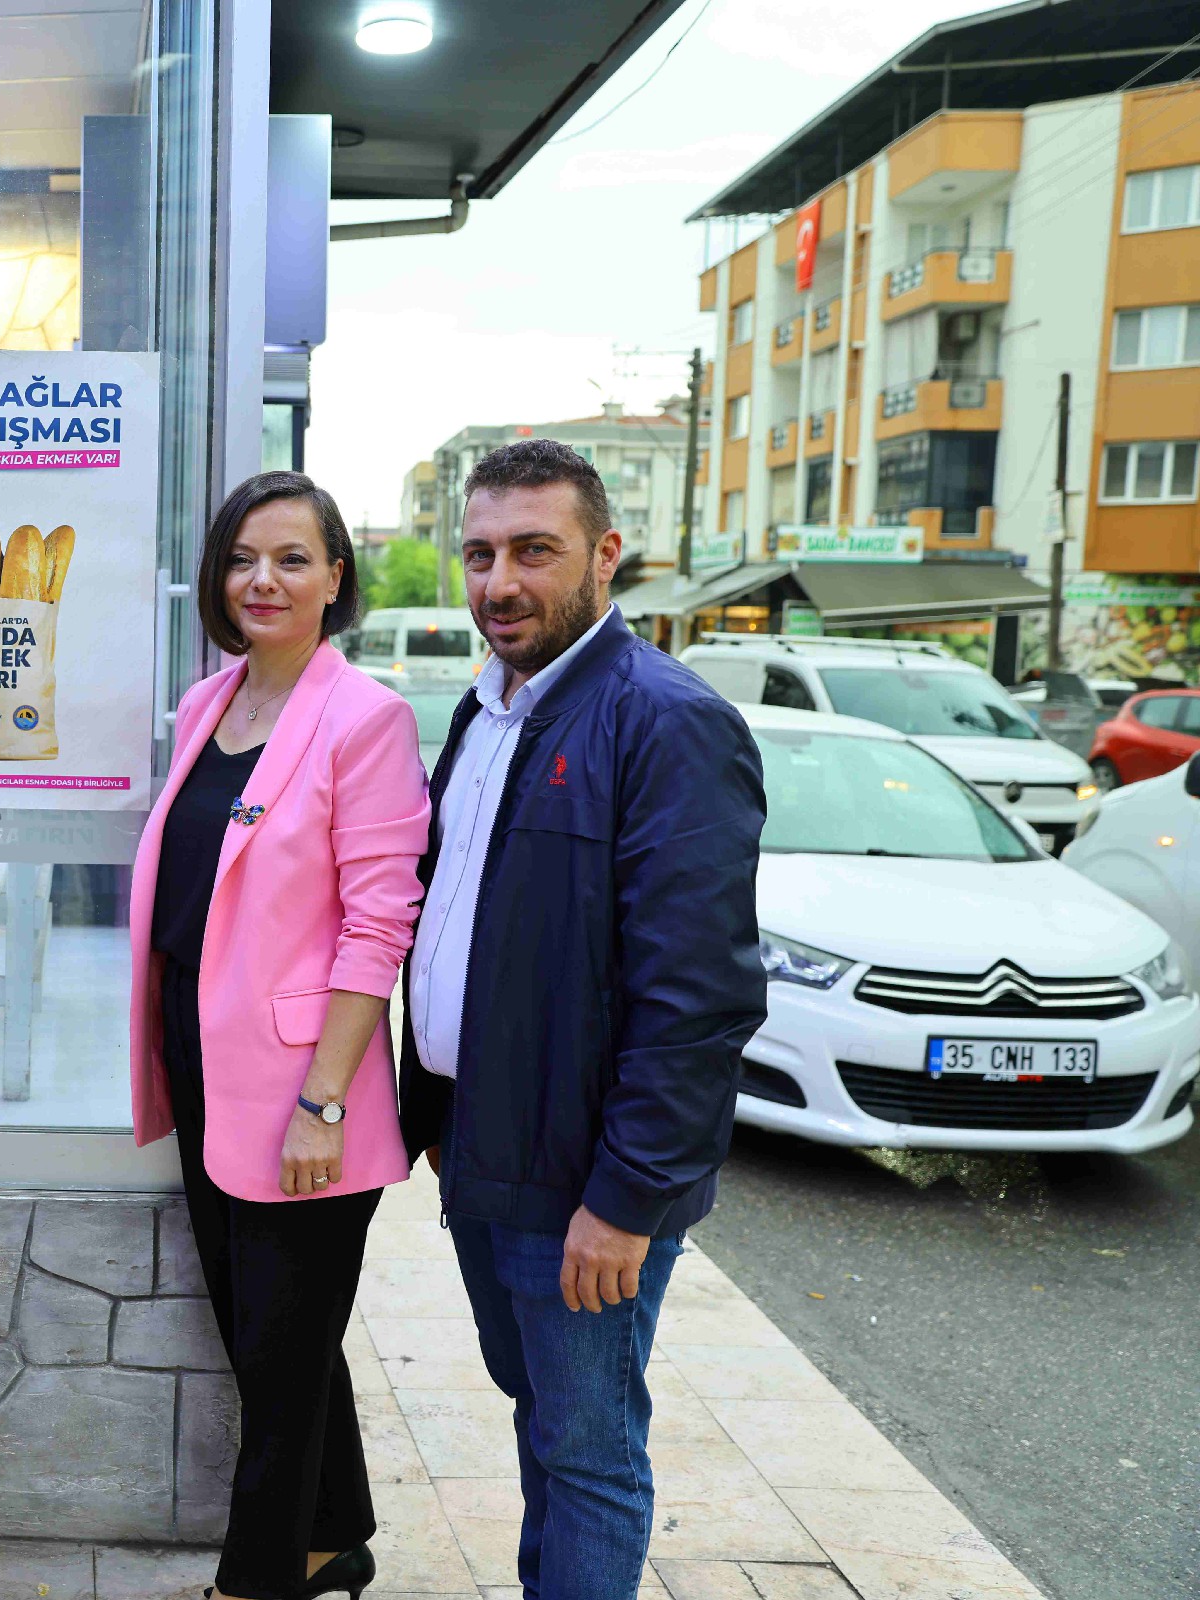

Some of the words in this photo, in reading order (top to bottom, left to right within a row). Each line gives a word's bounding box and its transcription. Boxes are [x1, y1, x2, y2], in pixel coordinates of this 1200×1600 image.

[36, 453, 84, 465] EKMEK
[86, 453, 117, 464] VAR!
[75, 779, 82, 788] İŞ
[83, 778, 124, 787] BİRLİĞİYLE
[945, 1044, 974, 1069] 35
[991, 1045, 1034, 1071] CNH
[1052, 1047, 1091, 1072] 133
